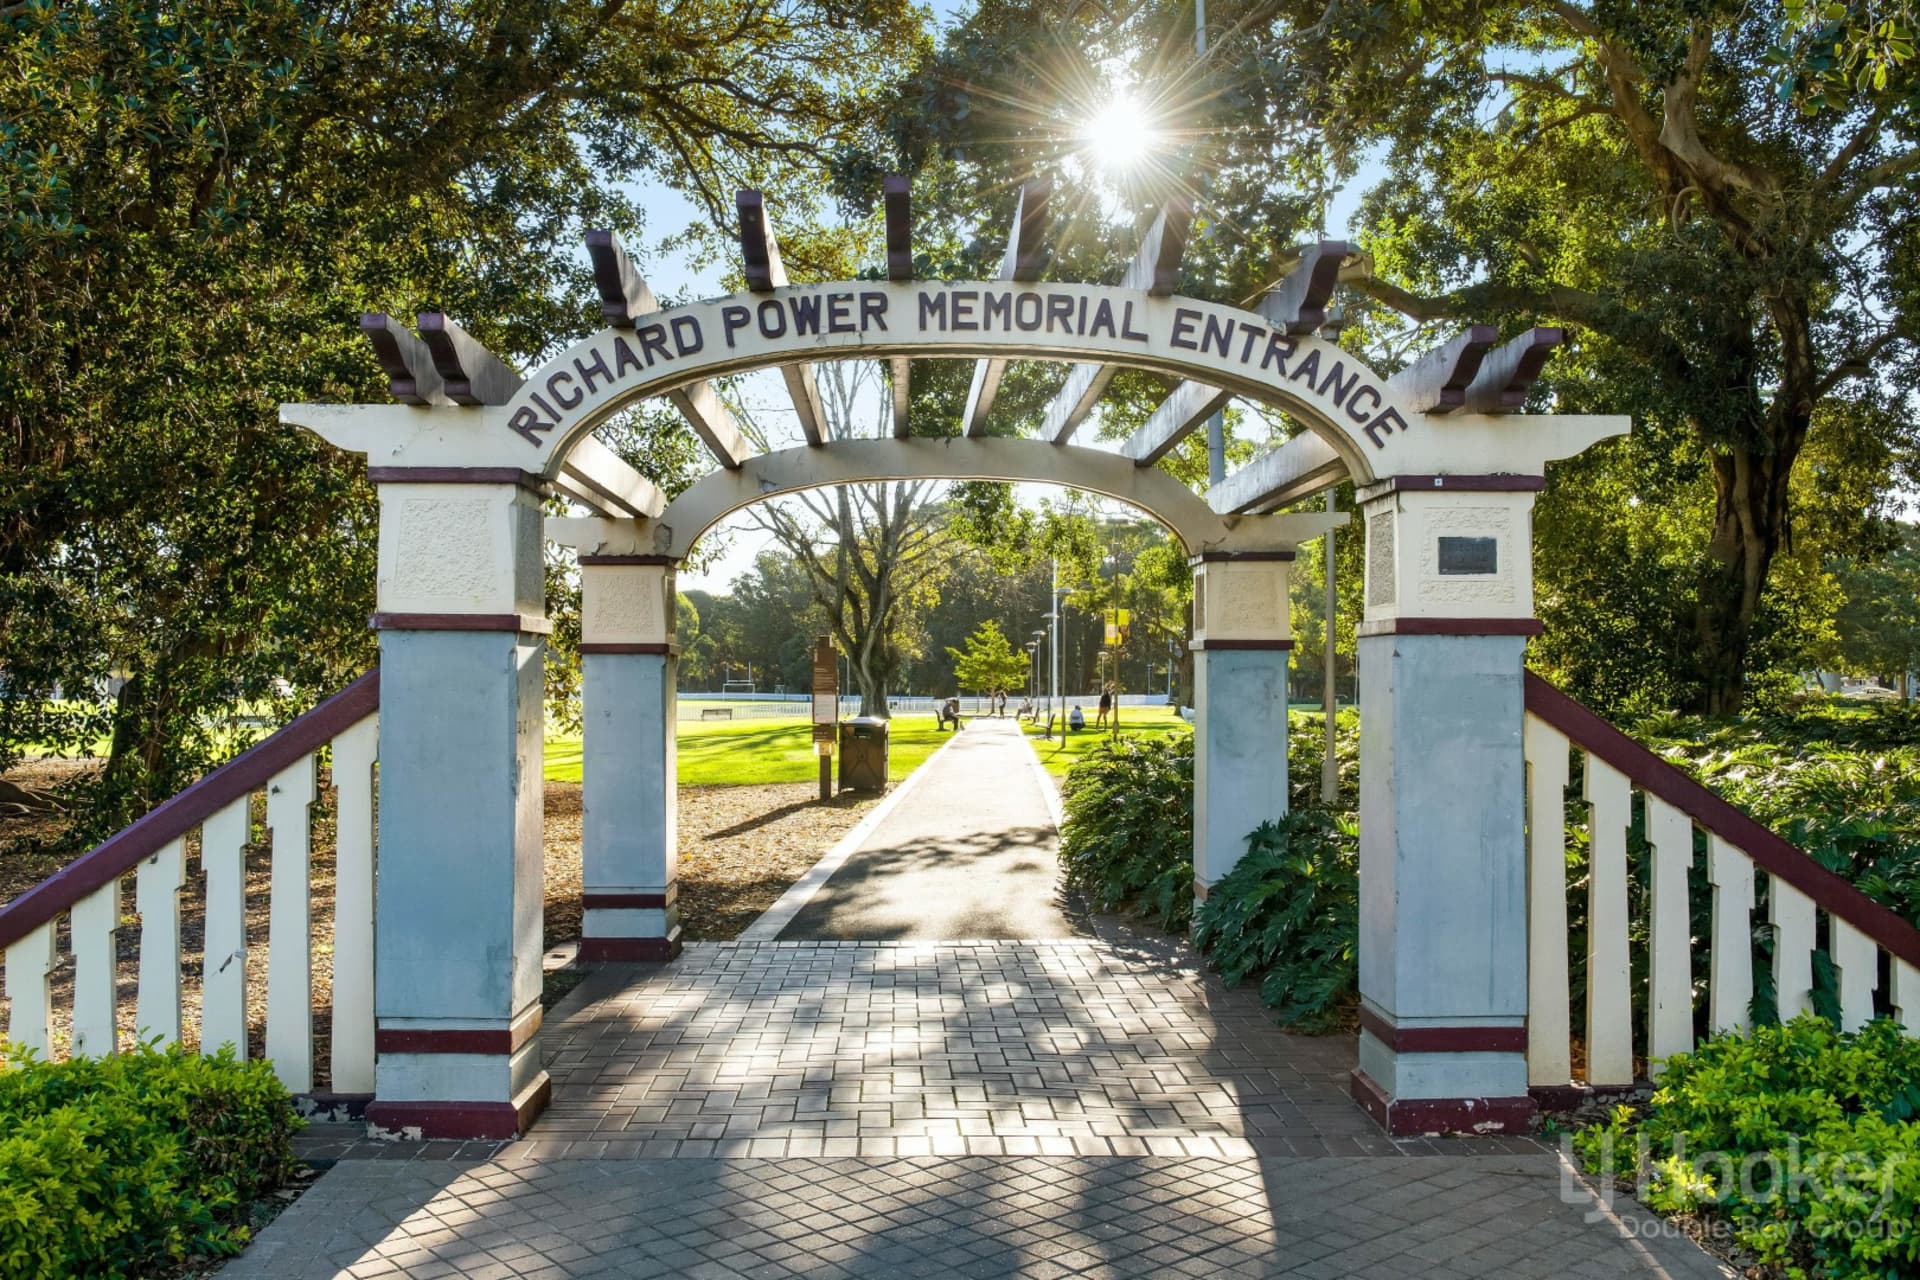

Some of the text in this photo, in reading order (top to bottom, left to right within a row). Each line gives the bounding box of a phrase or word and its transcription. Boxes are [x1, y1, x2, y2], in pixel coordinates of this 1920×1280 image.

[508, 291, 1408, 449] RICHARD POWER MEMORIAL ENTRANCE
